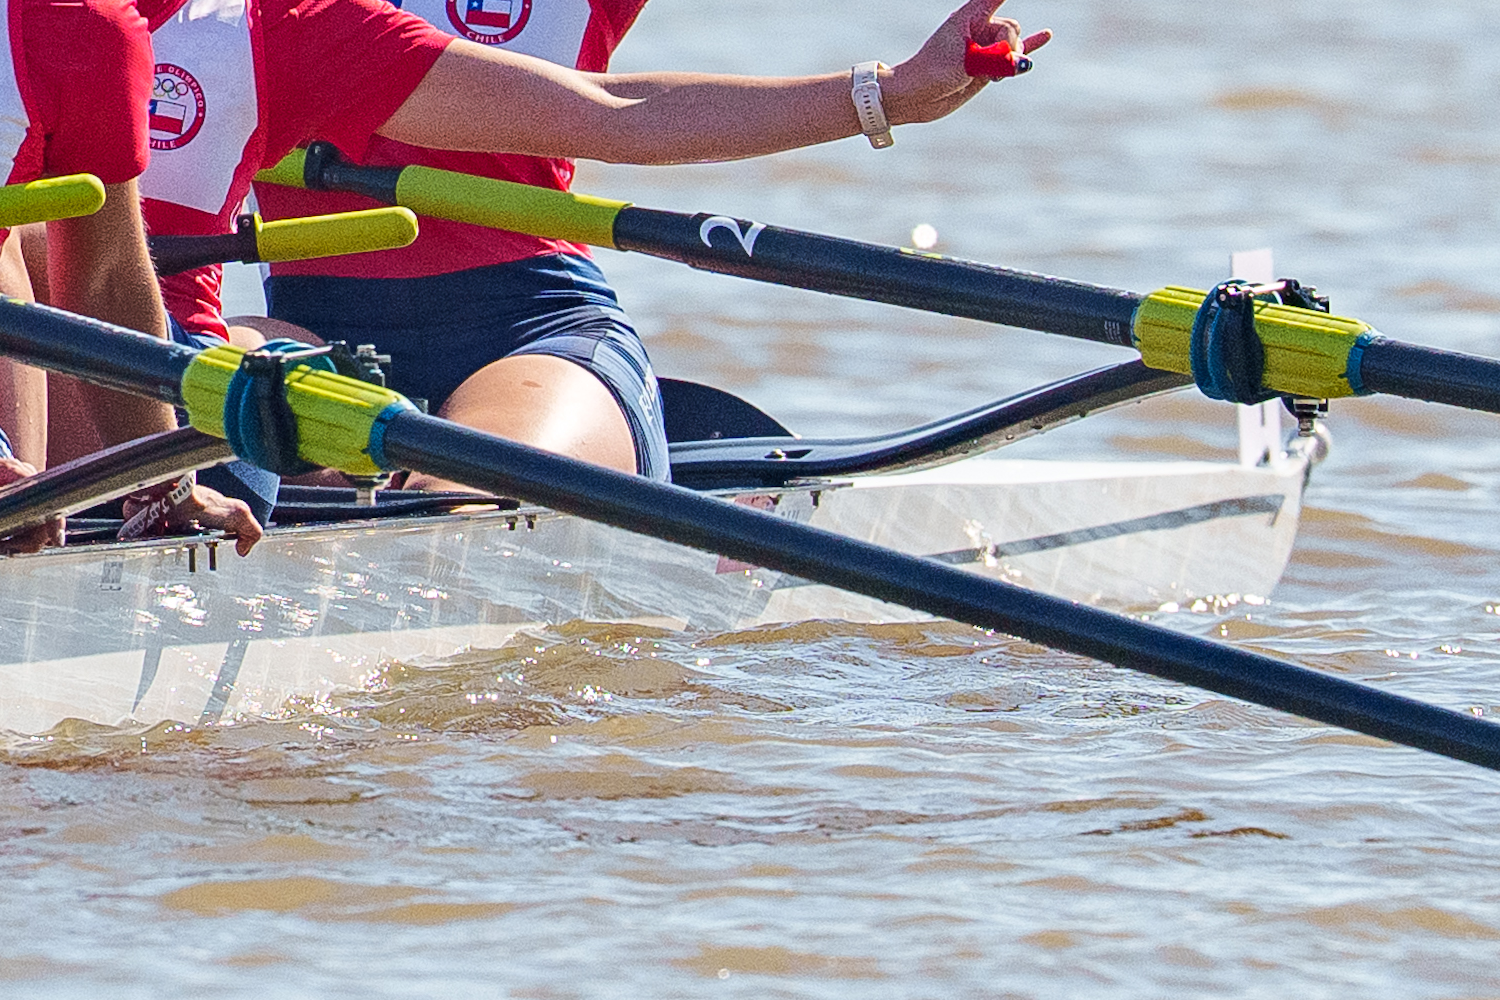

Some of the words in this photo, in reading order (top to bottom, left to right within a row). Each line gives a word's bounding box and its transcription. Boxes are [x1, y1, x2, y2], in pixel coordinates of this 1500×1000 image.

[466, 31, 505, 44] CHILE
[168, 66, 204, 108] OLIMPICO
[150, 140, 176, 149] HILE
[700, 216, 767, 257] 2
